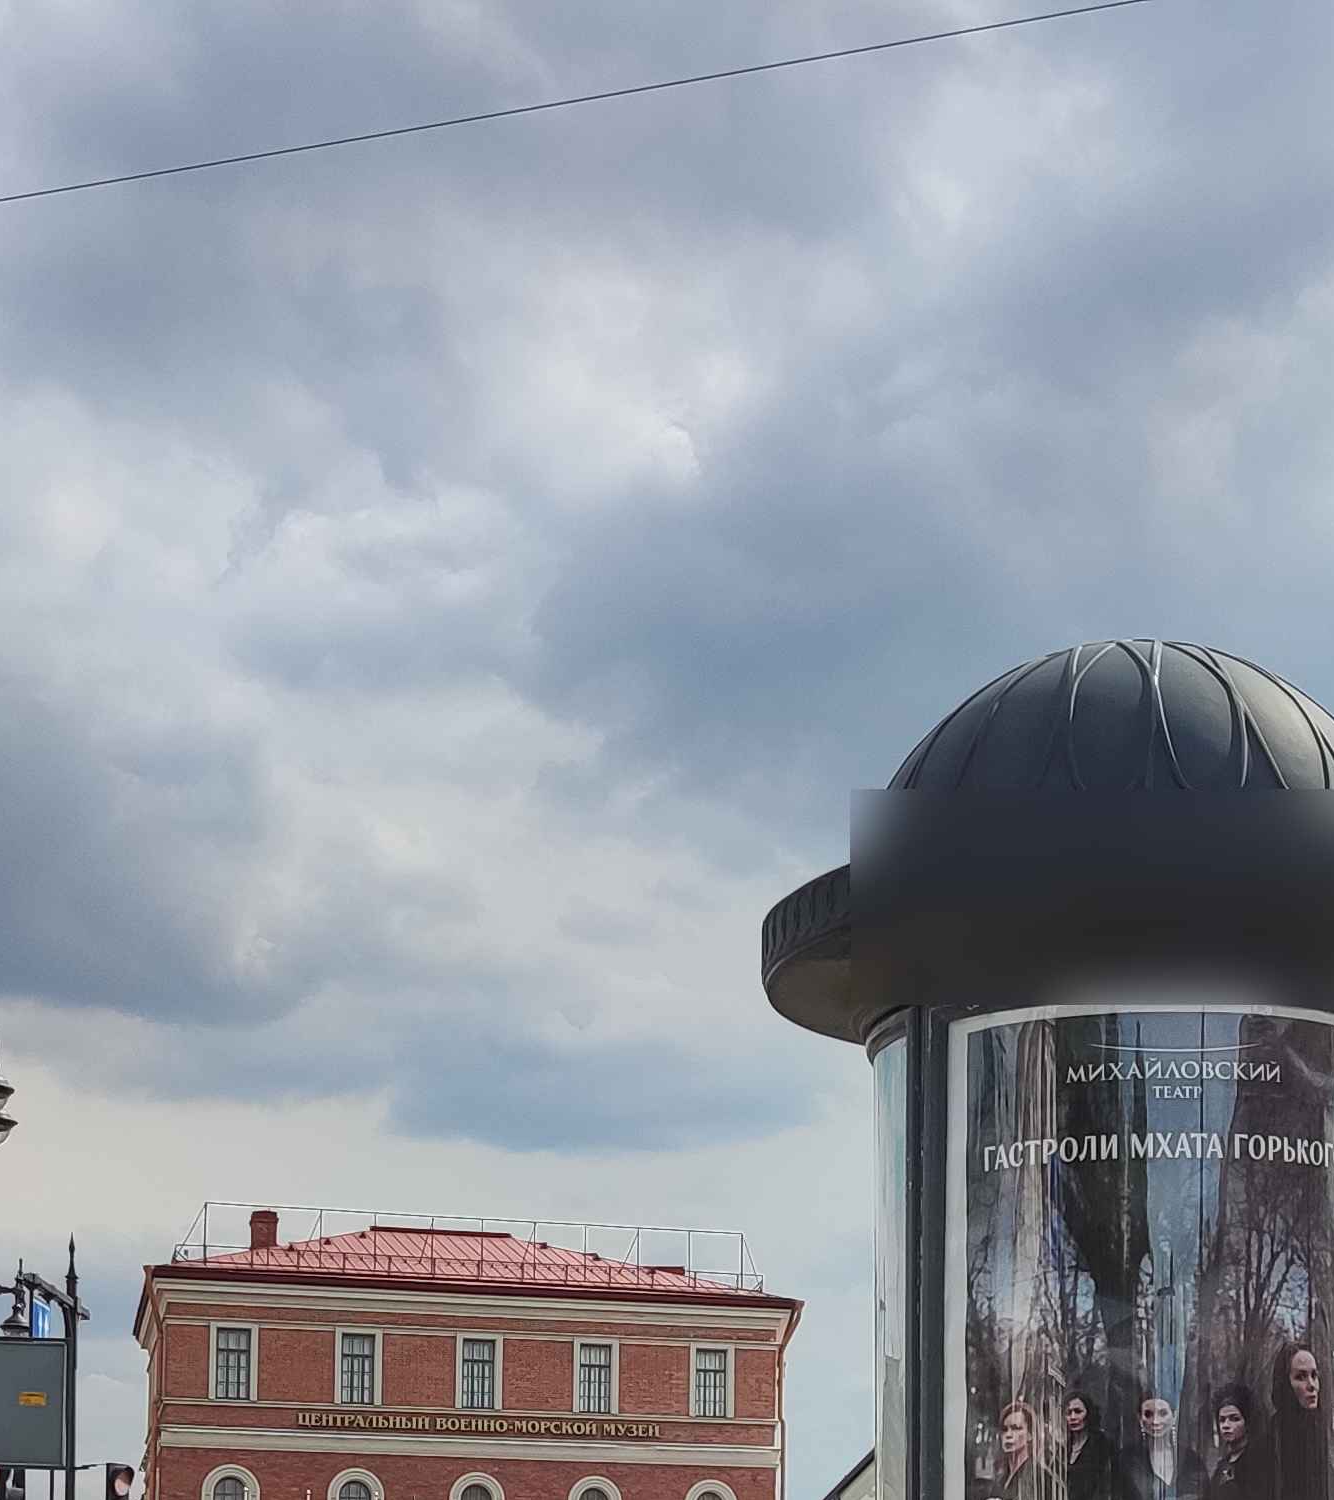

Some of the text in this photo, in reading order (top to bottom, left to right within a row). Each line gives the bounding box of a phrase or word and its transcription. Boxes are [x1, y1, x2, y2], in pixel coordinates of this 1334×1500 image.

[1066, 1057, 1281, 1084] МИХАЙЛОВСКИЙ
[1152, 1085, 1203, 1099] ТЕАТР
[983, 1134, 1118, 1172] ГАСТРОЛИ
[1131, 1132, 1224, 1159] МХАТА
[298, 1413, 660, 1437] ЦЕНТРАЛЬНЫЙ ВОЕННО-МОРСКОЙ МУЗЕЙ
